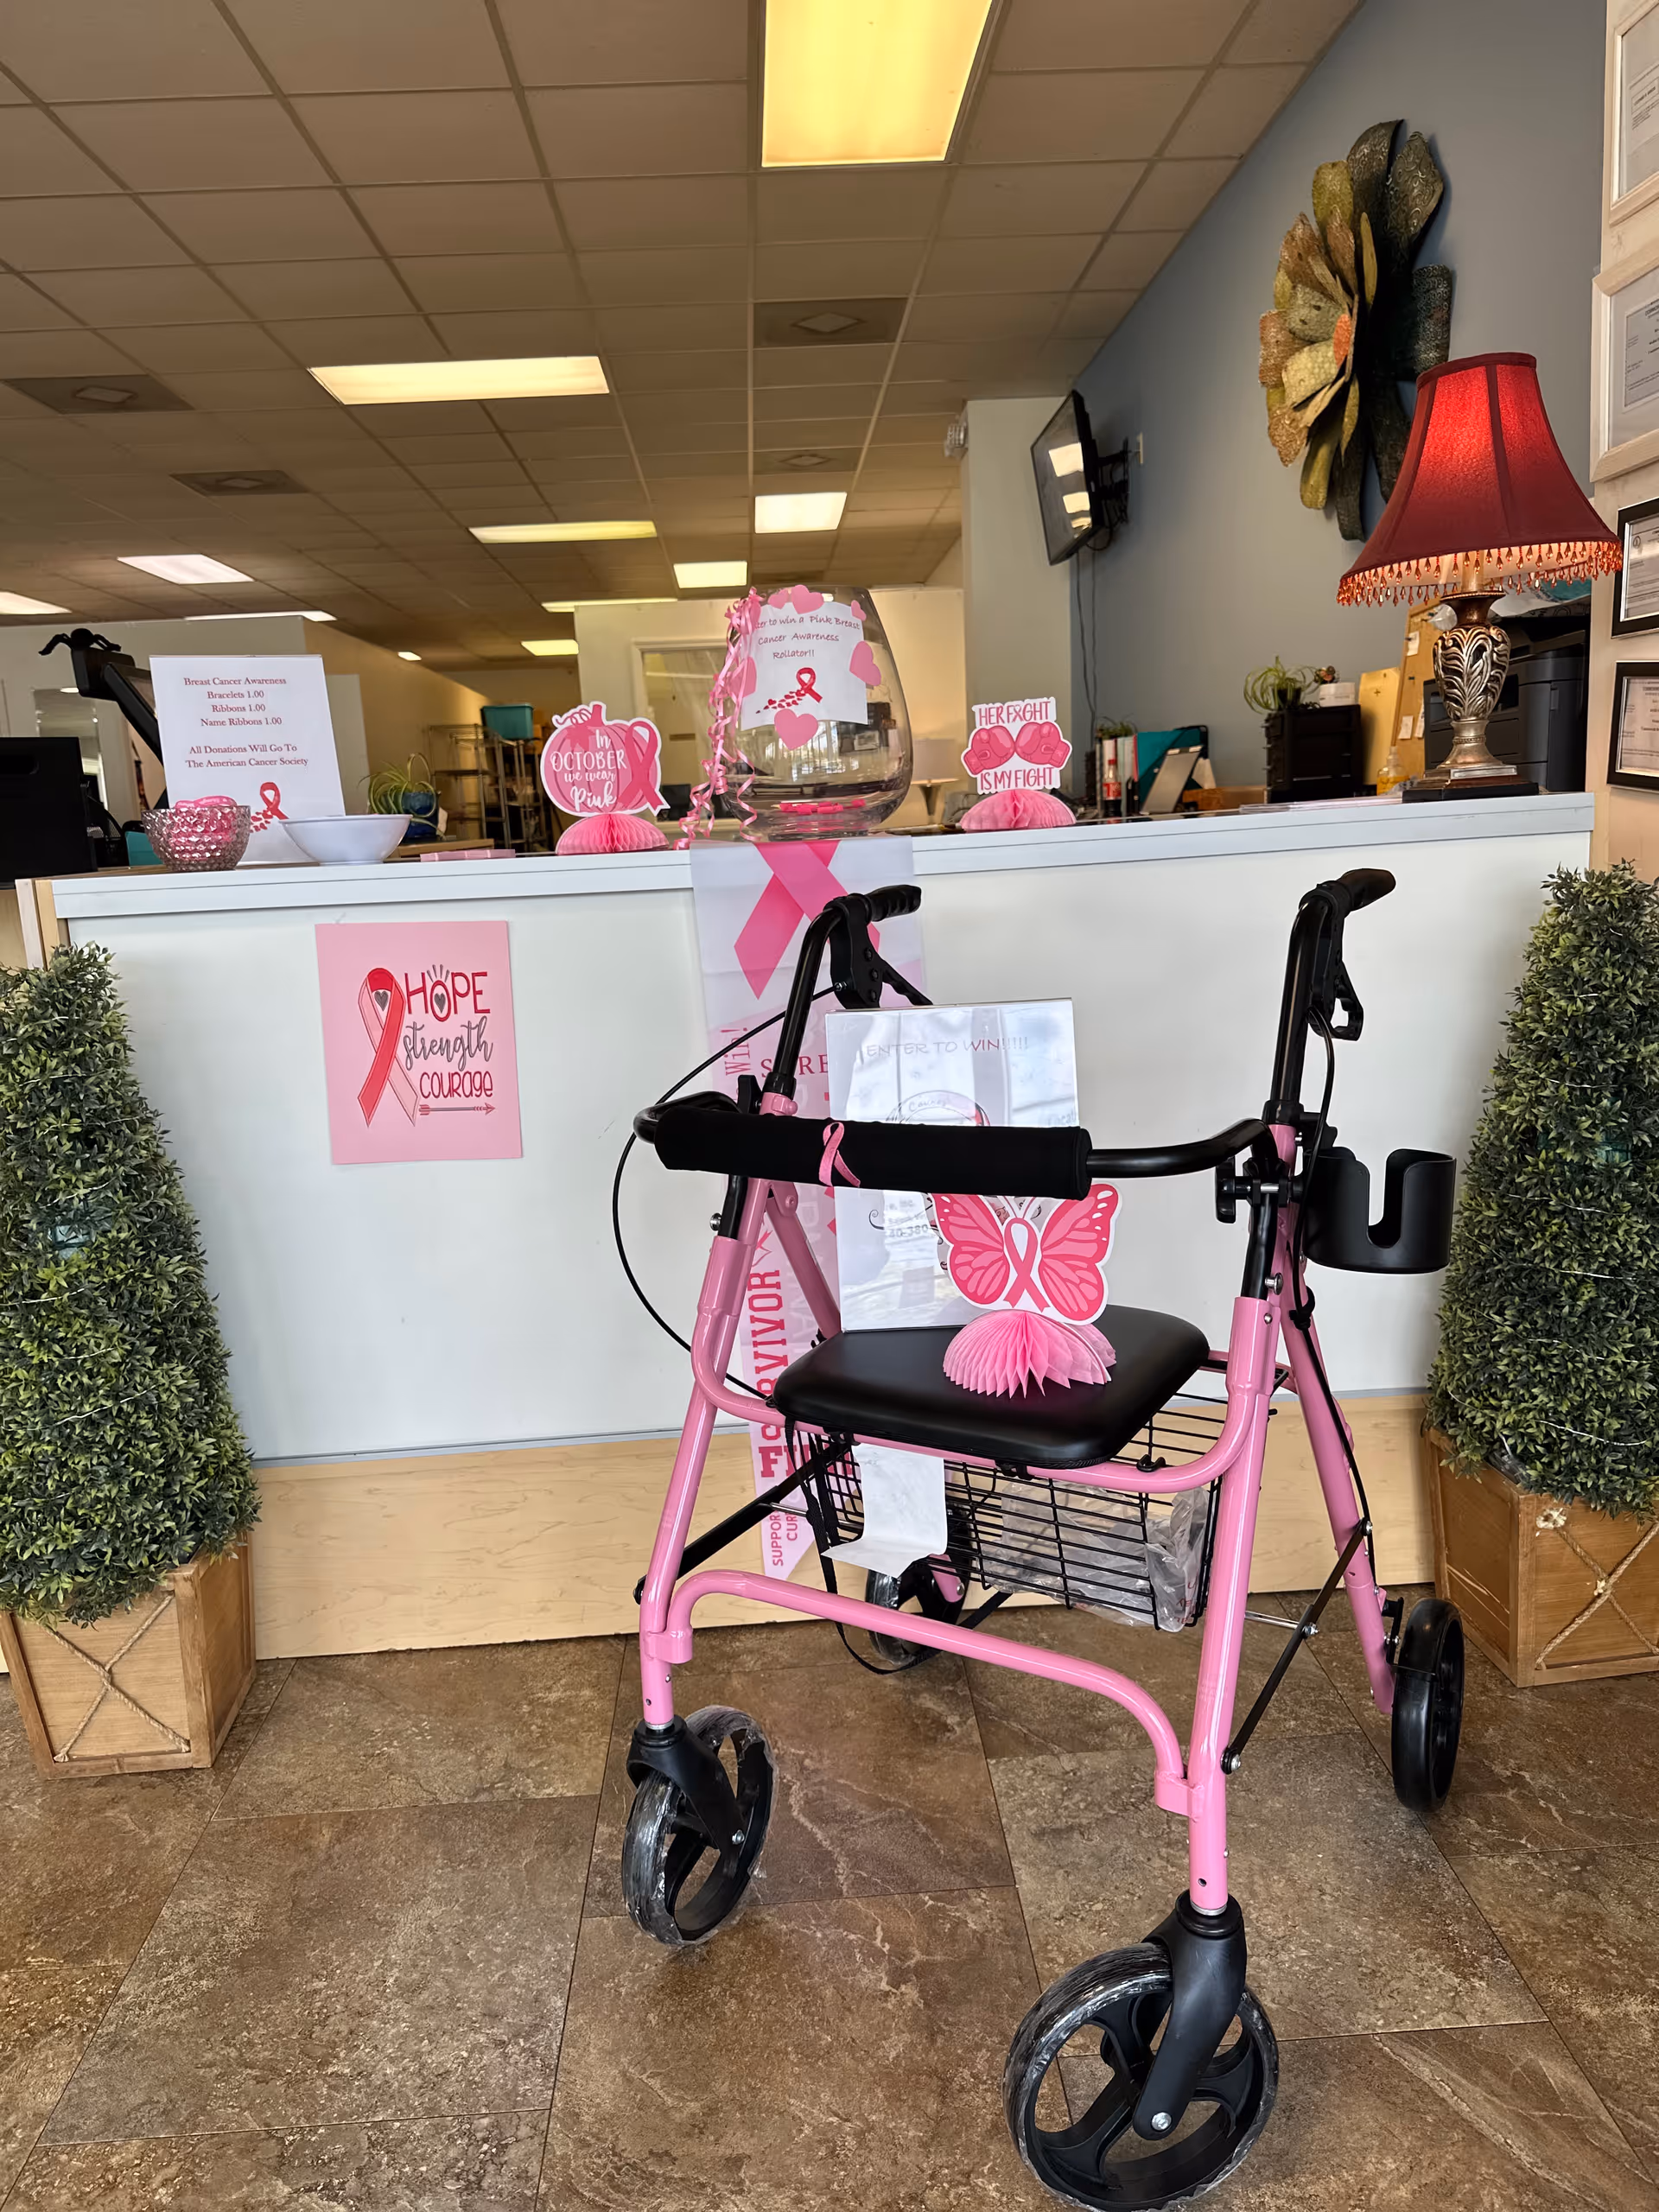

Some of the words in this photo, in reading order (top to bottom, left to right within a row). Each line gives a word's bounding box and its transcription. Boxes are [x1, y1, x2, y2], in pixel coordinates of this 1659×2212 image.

[754, 620, 767, 630] ter
[769, 618, 778, 626] to
[779, 615, 797, 625] win
[810, 615, 832, 624] Pink
[834, 617, 861, 630] Breast
[791, 632, 840, 642] Awareness
[772, 650, 815, 659] Rollator!!
[183, 677, 211, 686] Breast
[212, 704, 246, 713] Ribbons
[979, 705, 1005, 726] HER
[200, 718, 226, 727] Name
[595, 729, 611, 749] In
[189, 746, 202, 754] All
[248, 744, 267, 753] Will
[186, 760, 204, 768] The
[206, 759, 246, 767] American
[248, 758, 277, 766] Cancer
[280, 757, 308, 766] Society
[550, 749, 627, 772] OCTOBER
[564, 771, 582, 782] we
[586, 771, 616, 782] wear
[980, 772, 992, 791] IS
[994, 769, 1012, 790] MY
[1014, 766, 1054, 788] FIGHT
[570, 781, 617, 811] Pink
[404, 971, 491, 1022] HOPE
[404, 1015, 493, 1071] strength
[866, 1042, 929, 1057] ENTER
[933, 1041, 957, 1053] TO
[786, 1512, 798, 1541] CUR
[769, 1512, 784, 1567] SUPPOR
